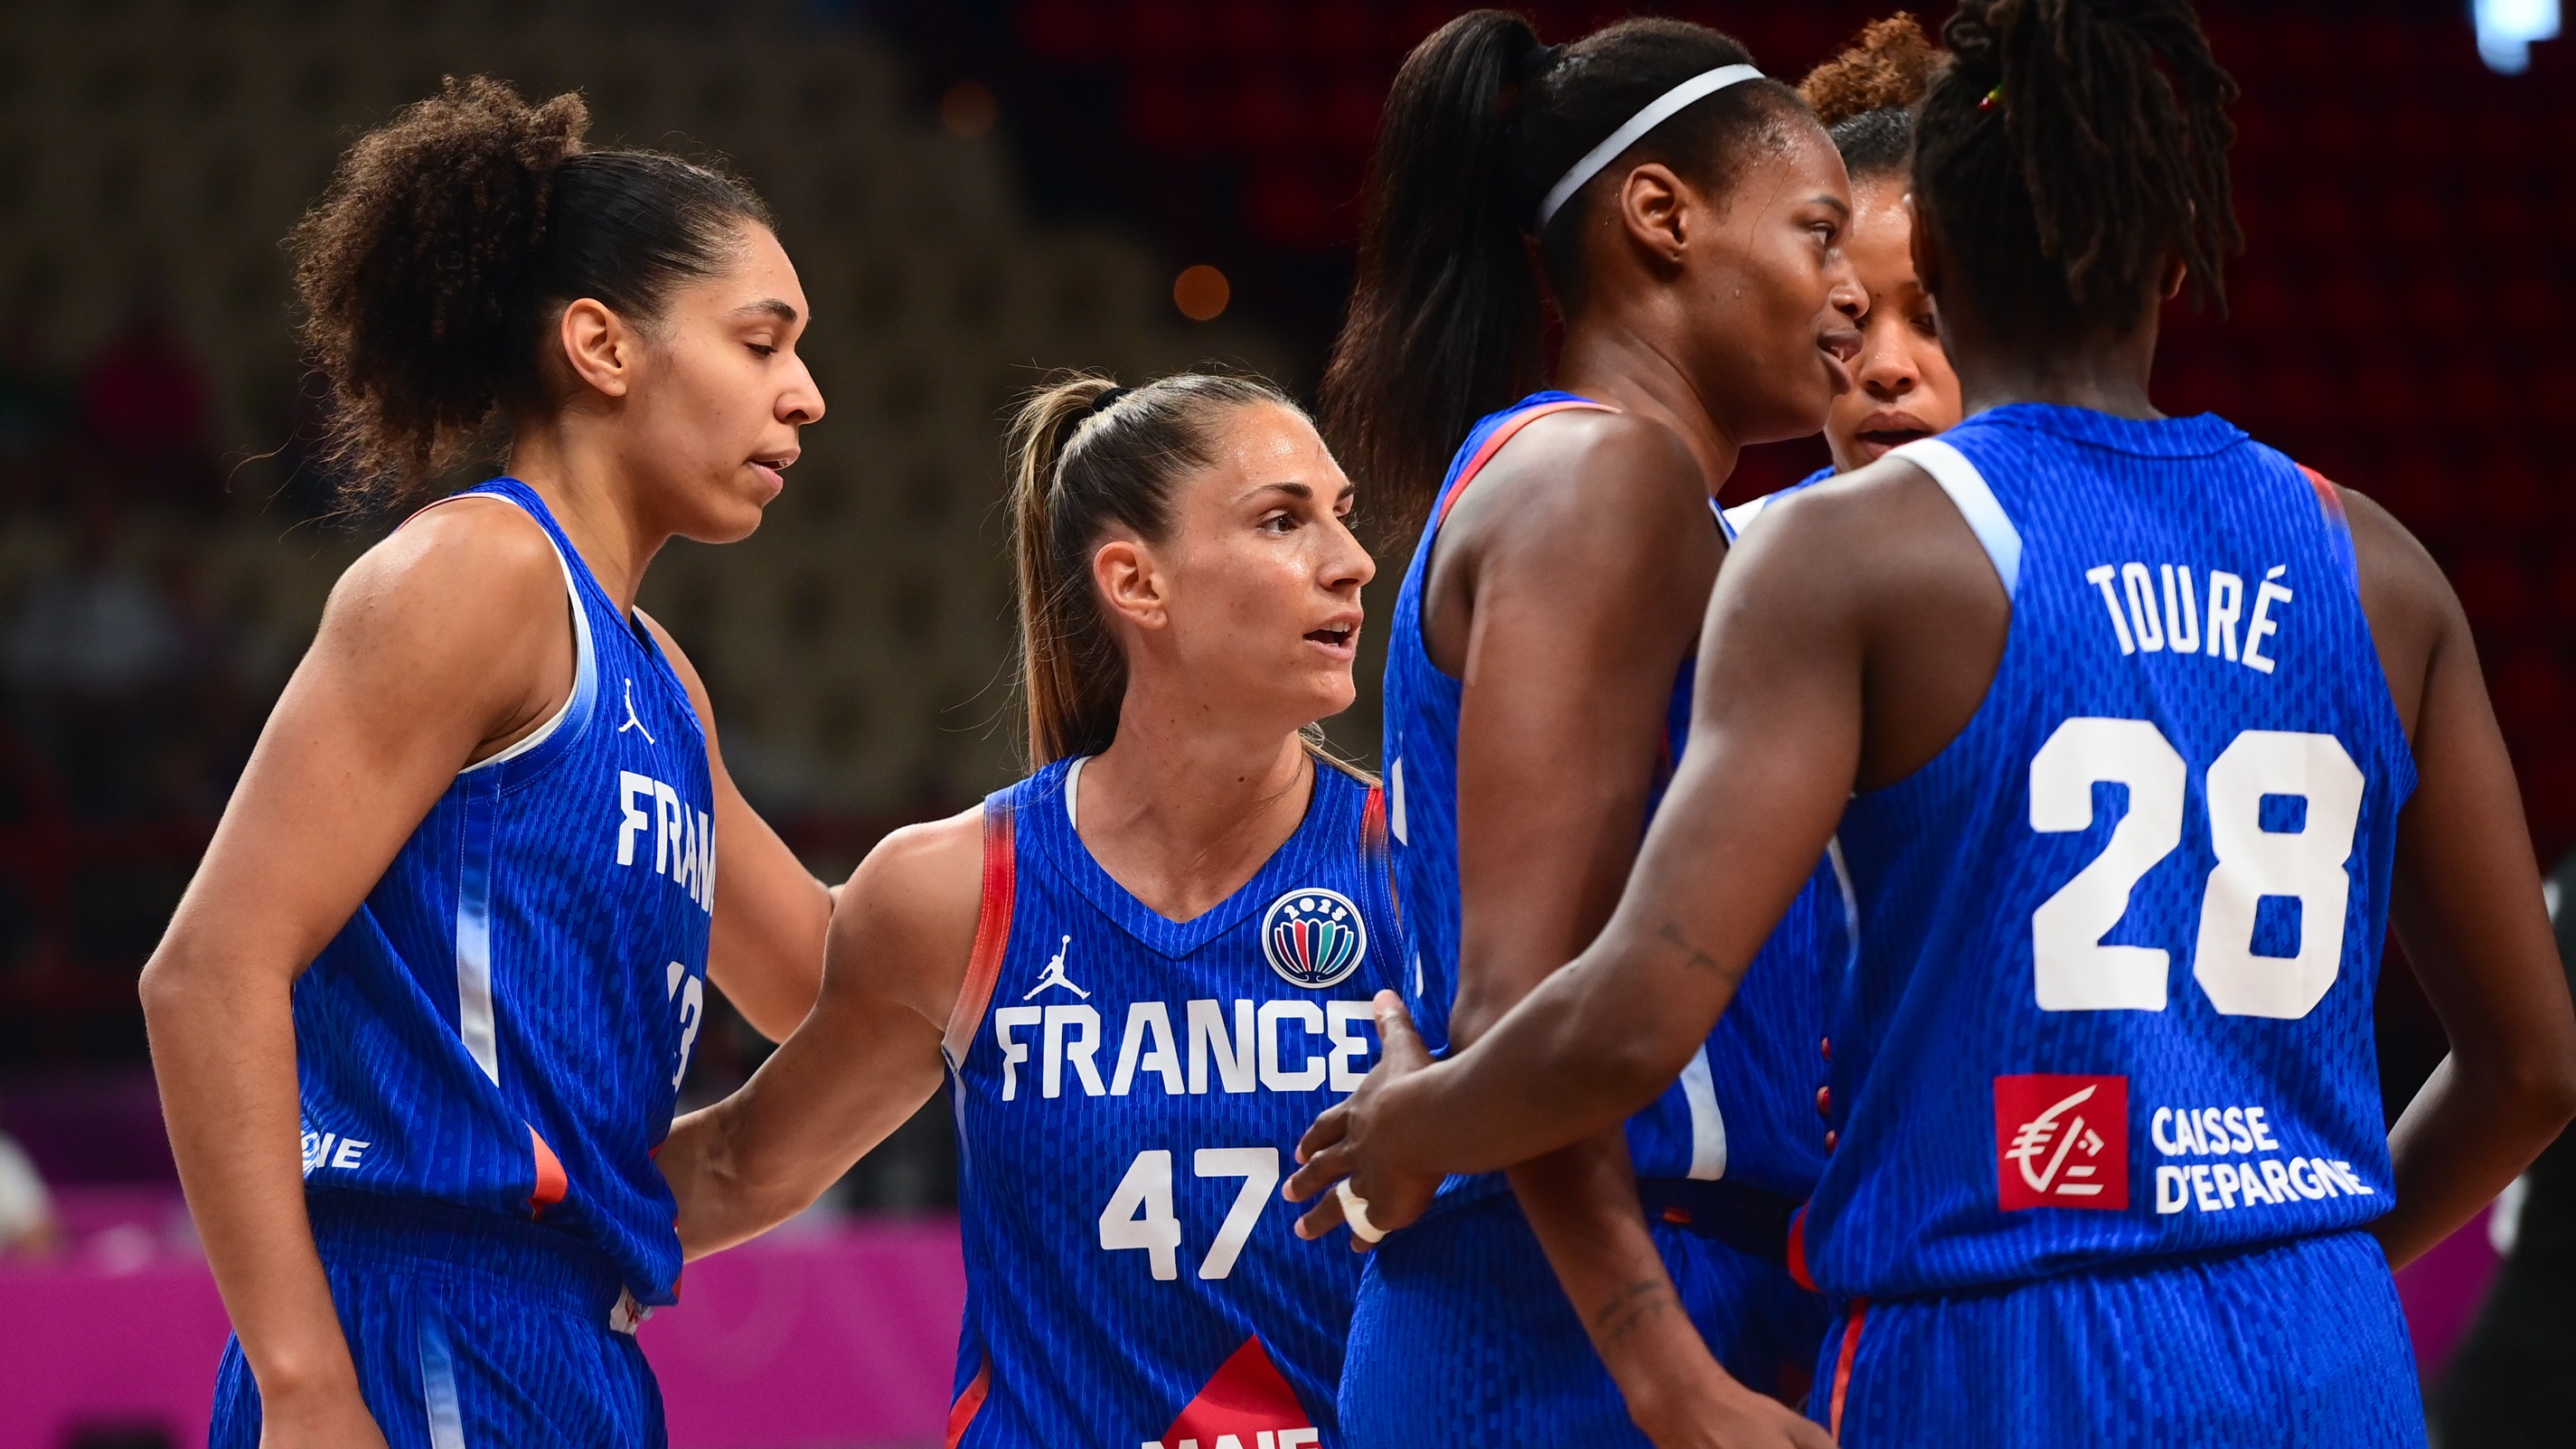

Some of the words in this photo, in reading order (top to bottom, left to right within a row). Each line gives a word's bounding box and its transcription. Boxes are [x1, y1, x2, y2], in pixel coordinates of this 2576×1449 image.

[2085, 561, 2293, 674] TOURÉ
[1283, 897, 1348, 922] 2025
[2028, 716, 2366, 1020] 28
[666, 960, 703, 1095] 3
[995, 998, 1377, 1102] FRANCE
[2150, 1106, 2280, 1157] CAISSE
[2155, 1156, 2375, 1215] D'EPARGNE
[1098, 1147, 1280, 1282] 47
